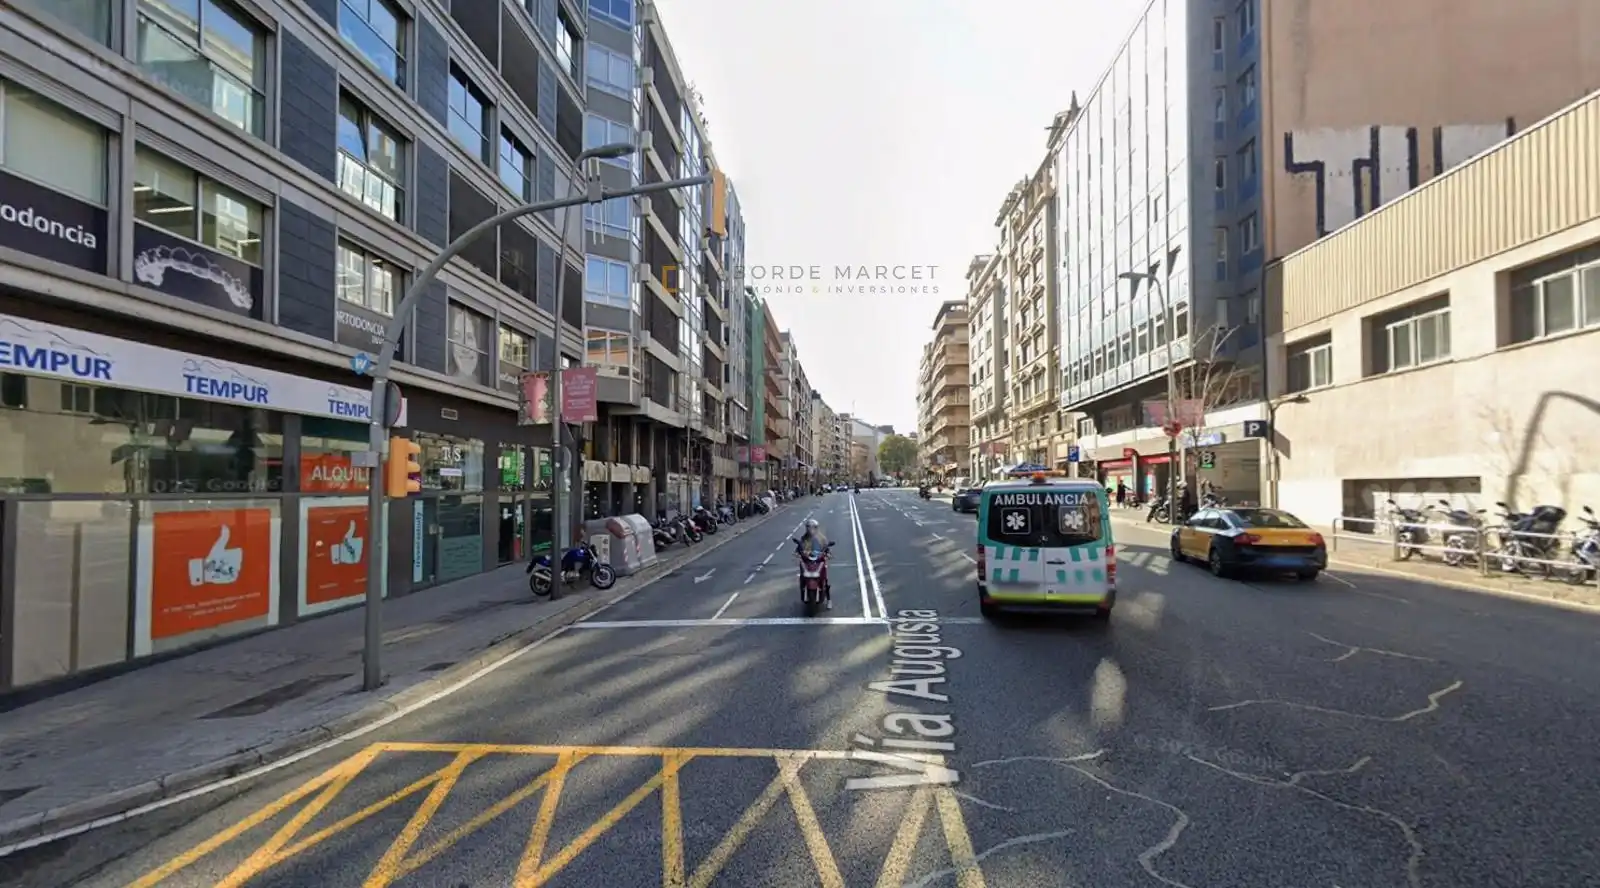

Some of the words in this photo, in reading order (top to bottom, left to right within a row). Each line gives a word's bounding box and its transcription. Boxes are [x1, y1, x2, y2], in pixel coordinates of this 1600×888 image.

[0, 205, 96, 249] odoncia
[183, 374, 269, 404] TEMPUR
[1249, 422, 1261, 434] P
[994, 493, 1089, 505] AMBULANCIA
